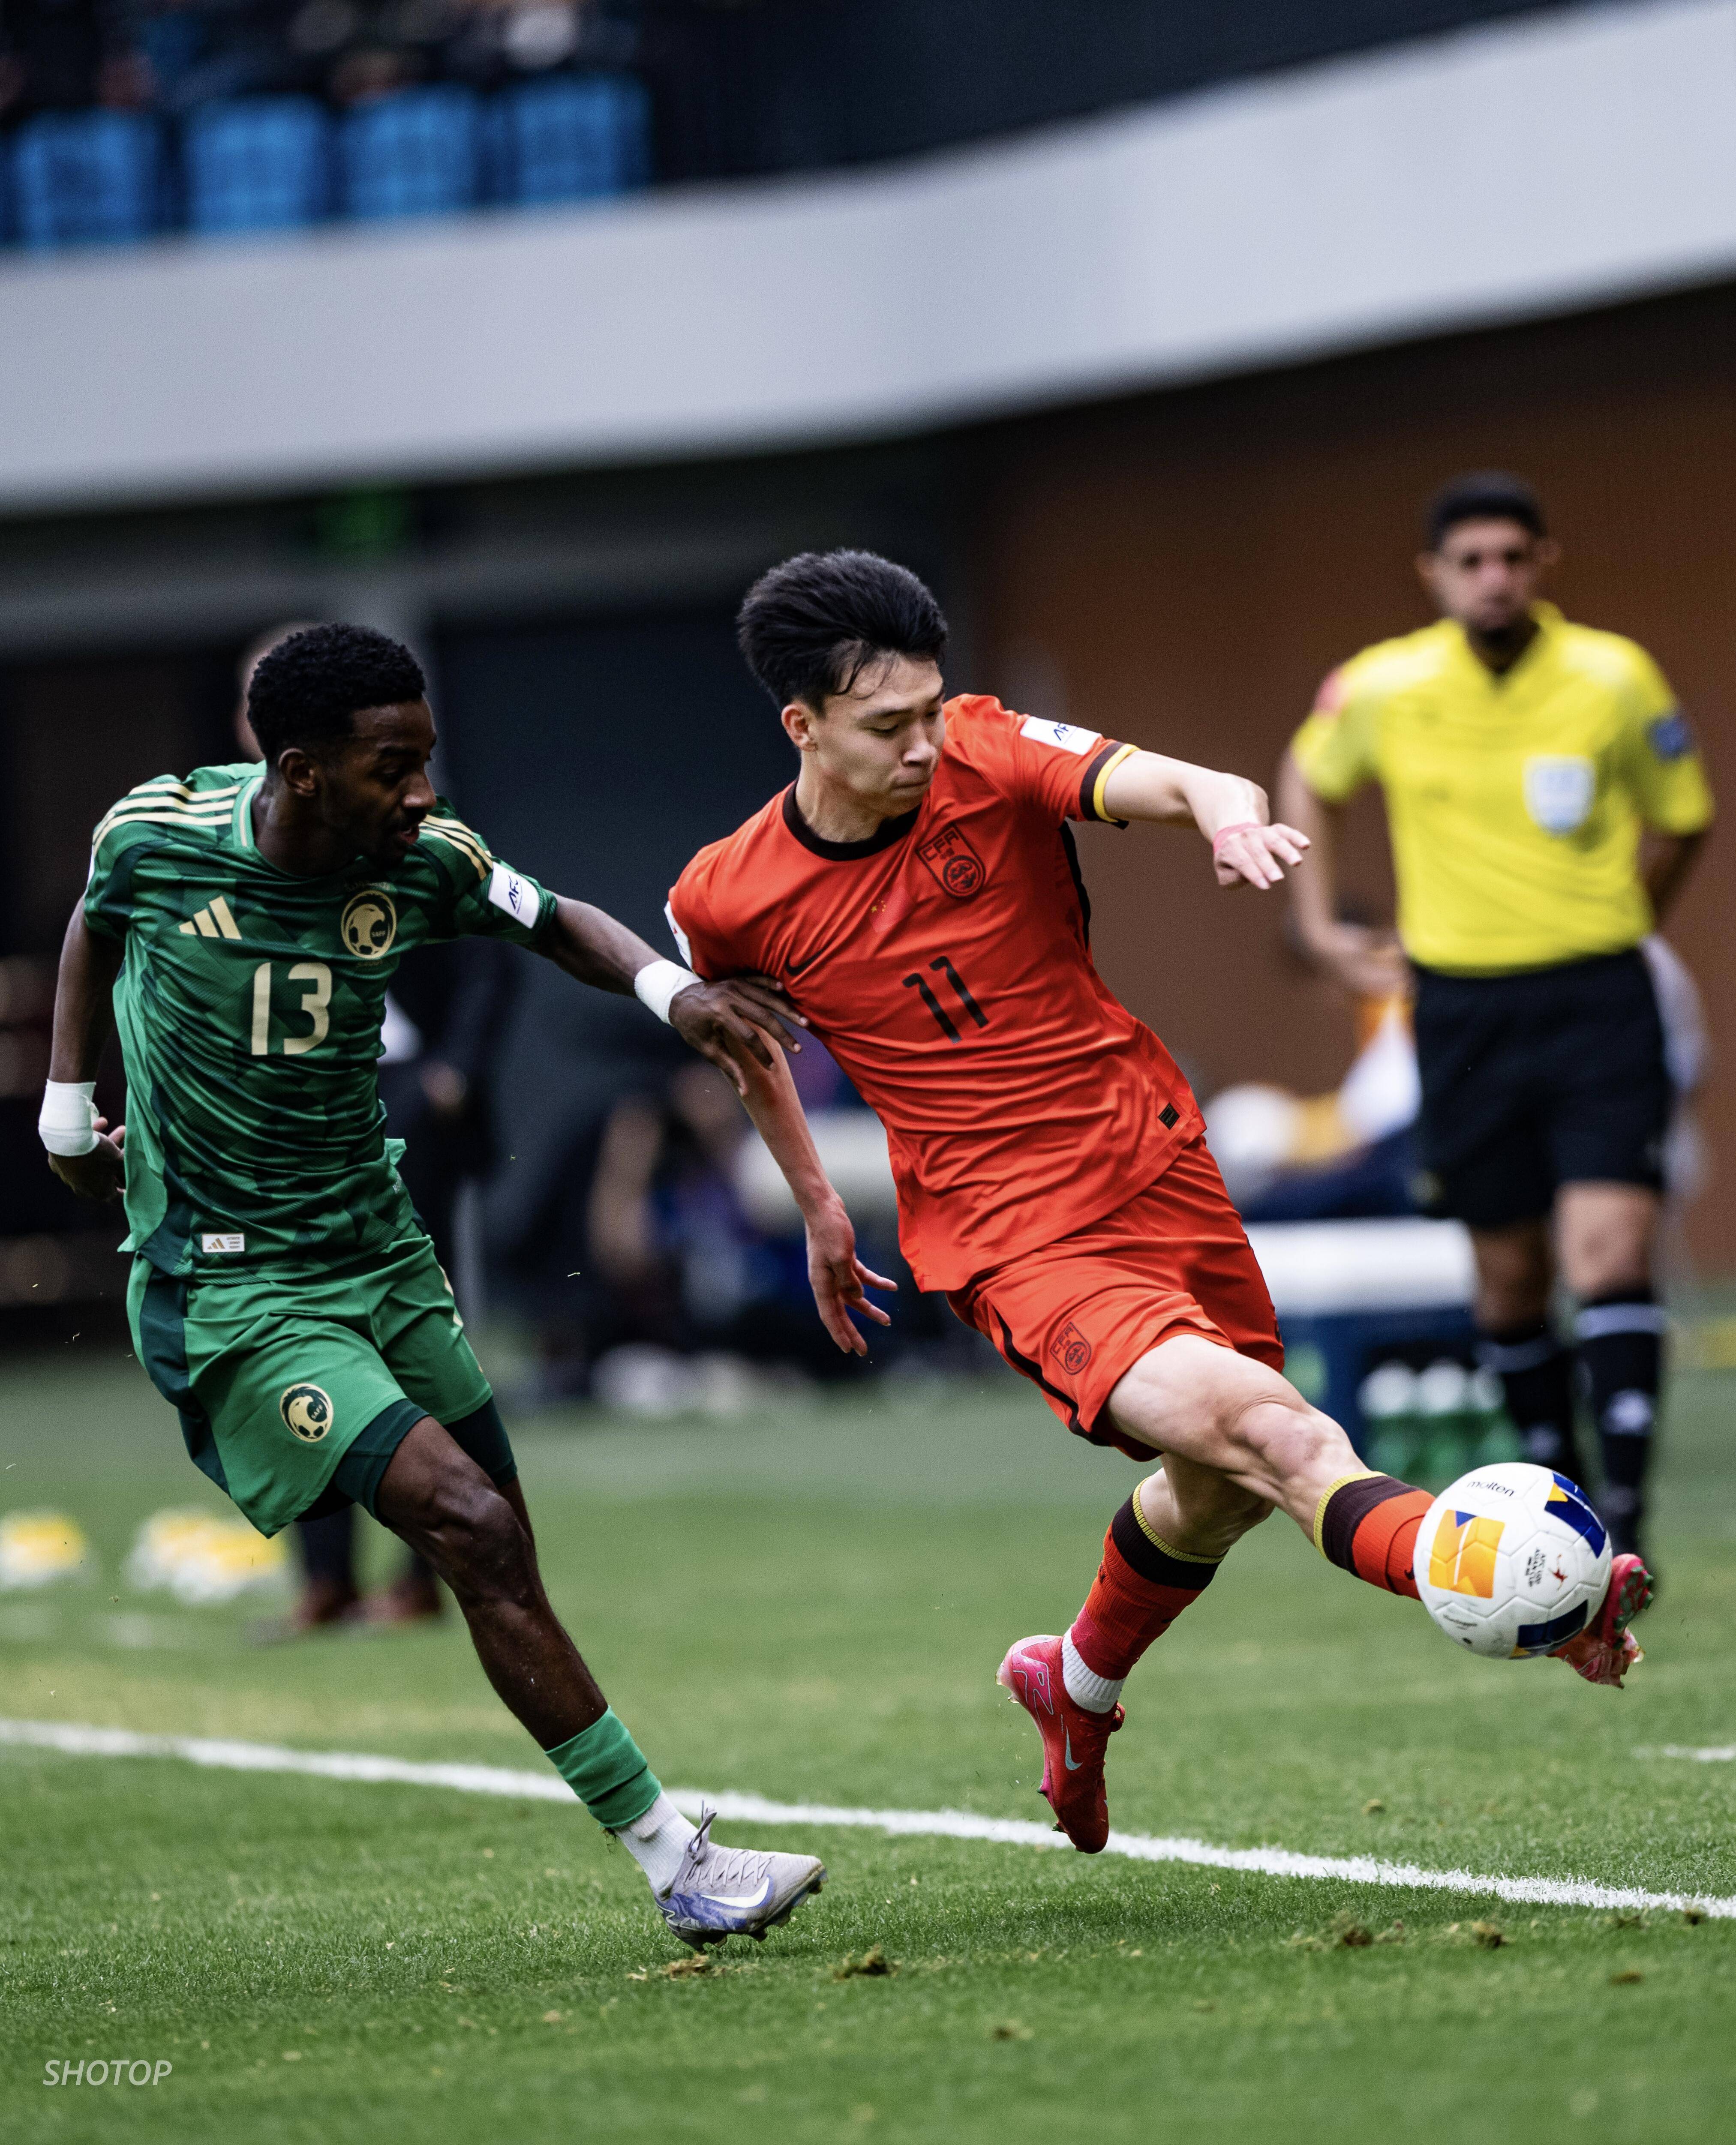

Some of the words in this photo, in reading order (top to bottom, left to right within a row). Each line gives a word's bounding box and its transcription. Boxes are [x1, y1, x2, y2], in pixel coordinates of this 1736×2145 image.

[1053, 722, 1069, 741] AF
[922, 831, 960, 861] CFA
[508, 874, 520, 910] AFC
[251, 962, 333, 1056] 13
[902, 956, 989, 1044] 11
[311, 1404, 323, 1419] SAFF
[1467, 1481, 1515, 1497] molten
